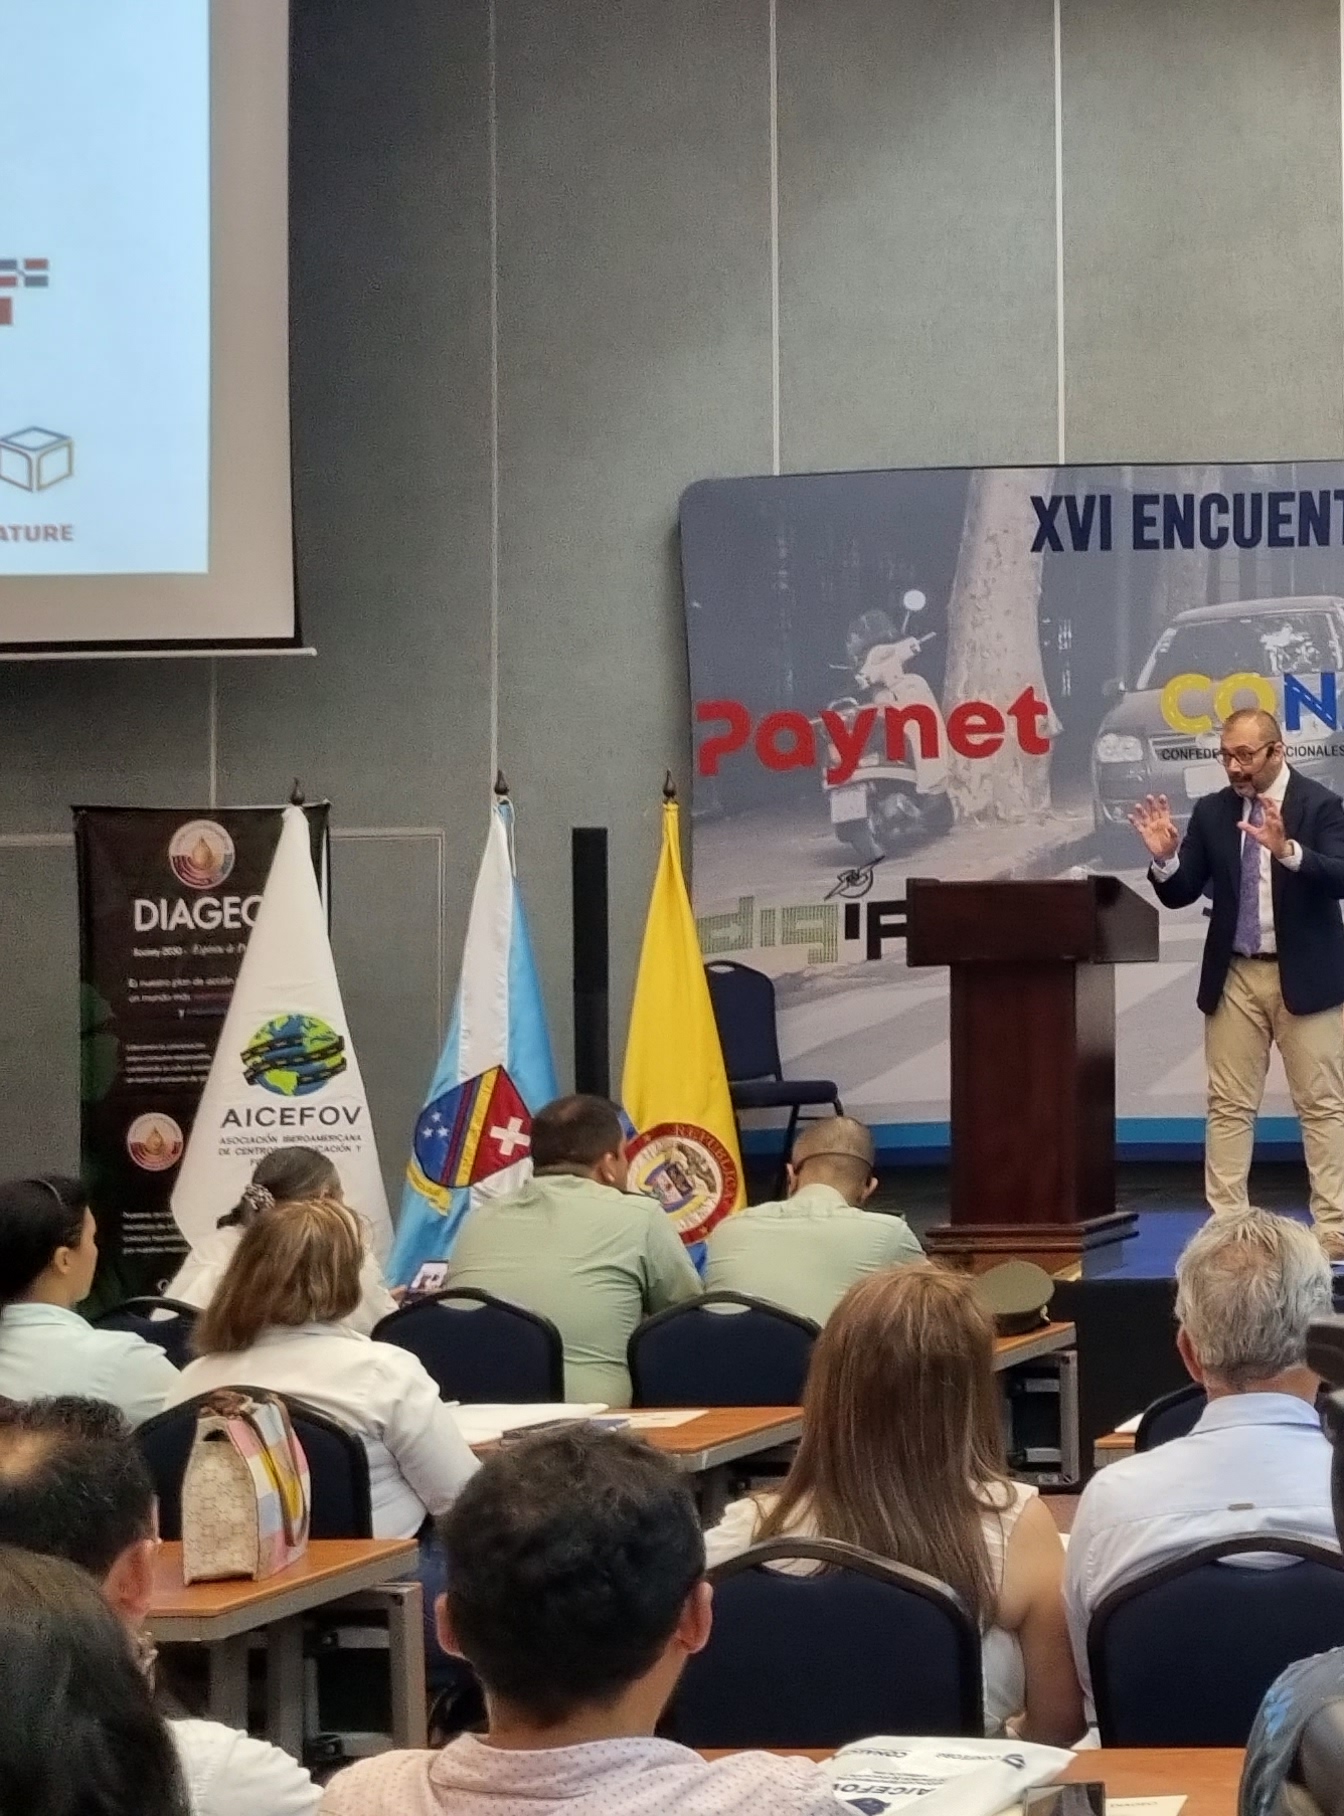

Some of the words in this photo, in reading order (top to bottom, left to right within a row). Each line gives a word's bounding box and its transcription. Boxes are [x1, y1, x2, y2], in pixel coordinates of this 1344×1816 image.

[1030, 494, 1112, 552] XVI
[697, 686, 1052, 786] Paynet
[1162, 748, 1219, 760] CONFEDE
[221, 1106, 361, 1128] AICEFOV
[235, 1145, 275, 1155] CENTRO
